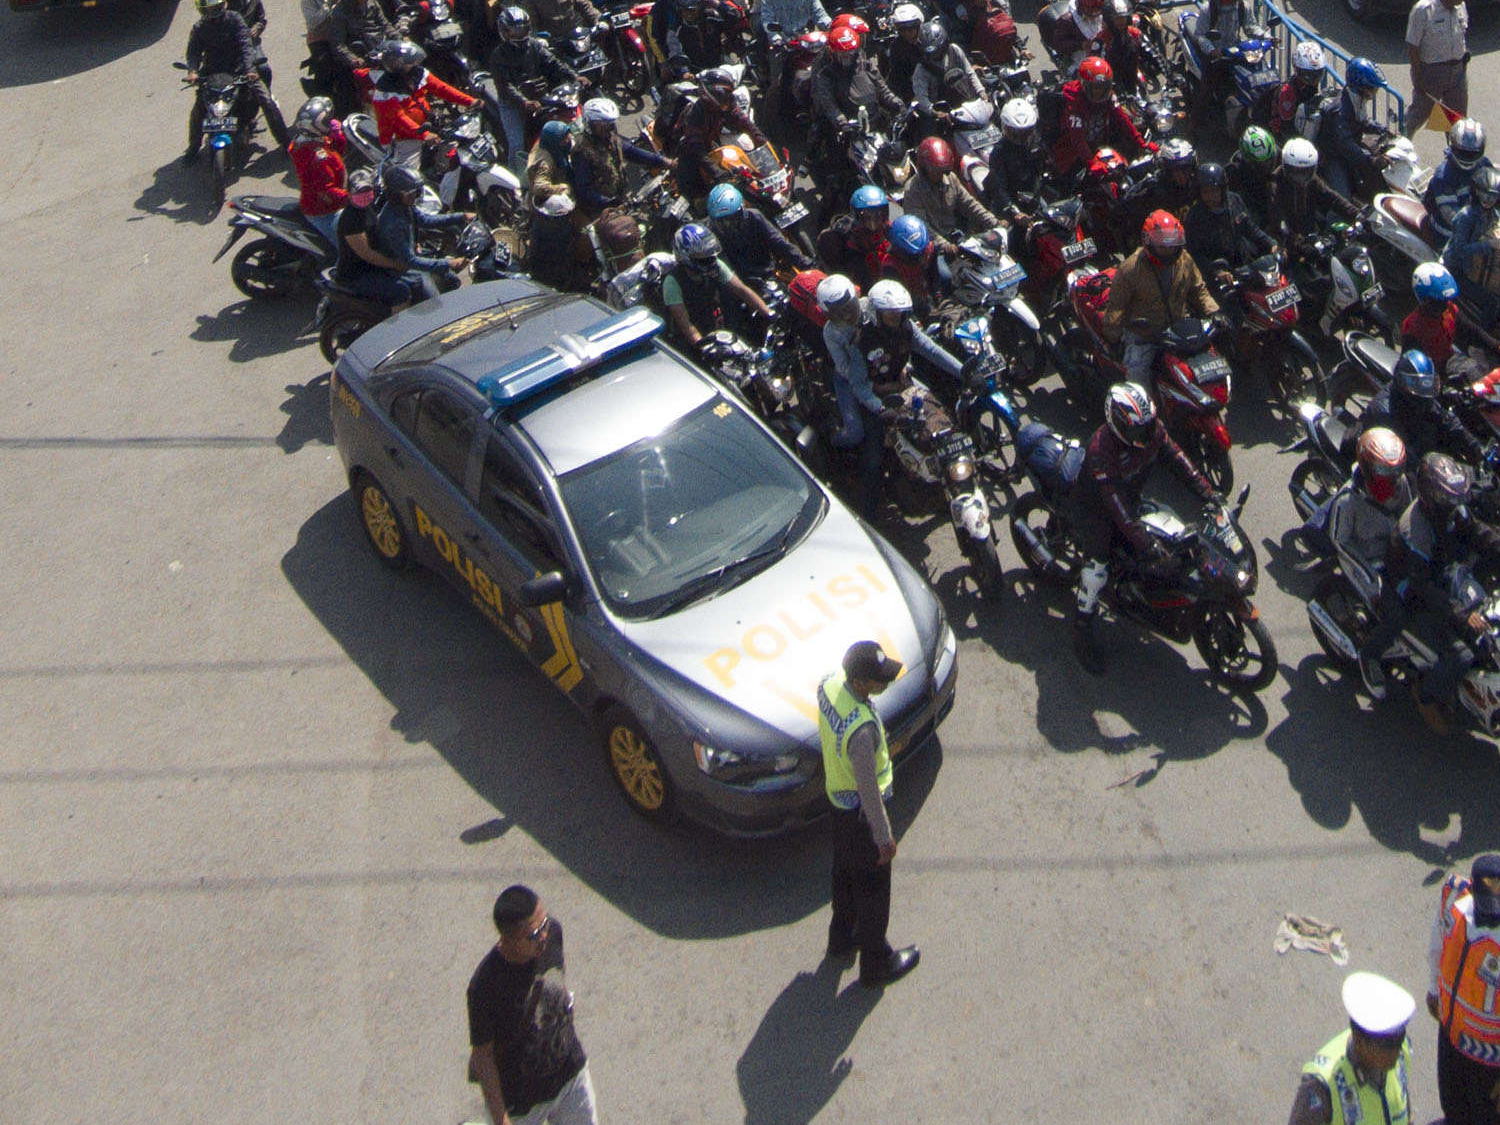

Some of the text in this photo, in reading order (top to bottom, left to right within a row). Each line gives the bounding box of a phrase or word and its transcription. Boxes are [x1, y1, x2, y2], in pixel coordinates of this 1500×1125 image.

[1069, 114, 1082, 128] 72
[413, 505, 505, 616] POLISI
[703, 564, 888, 690] POLISI
